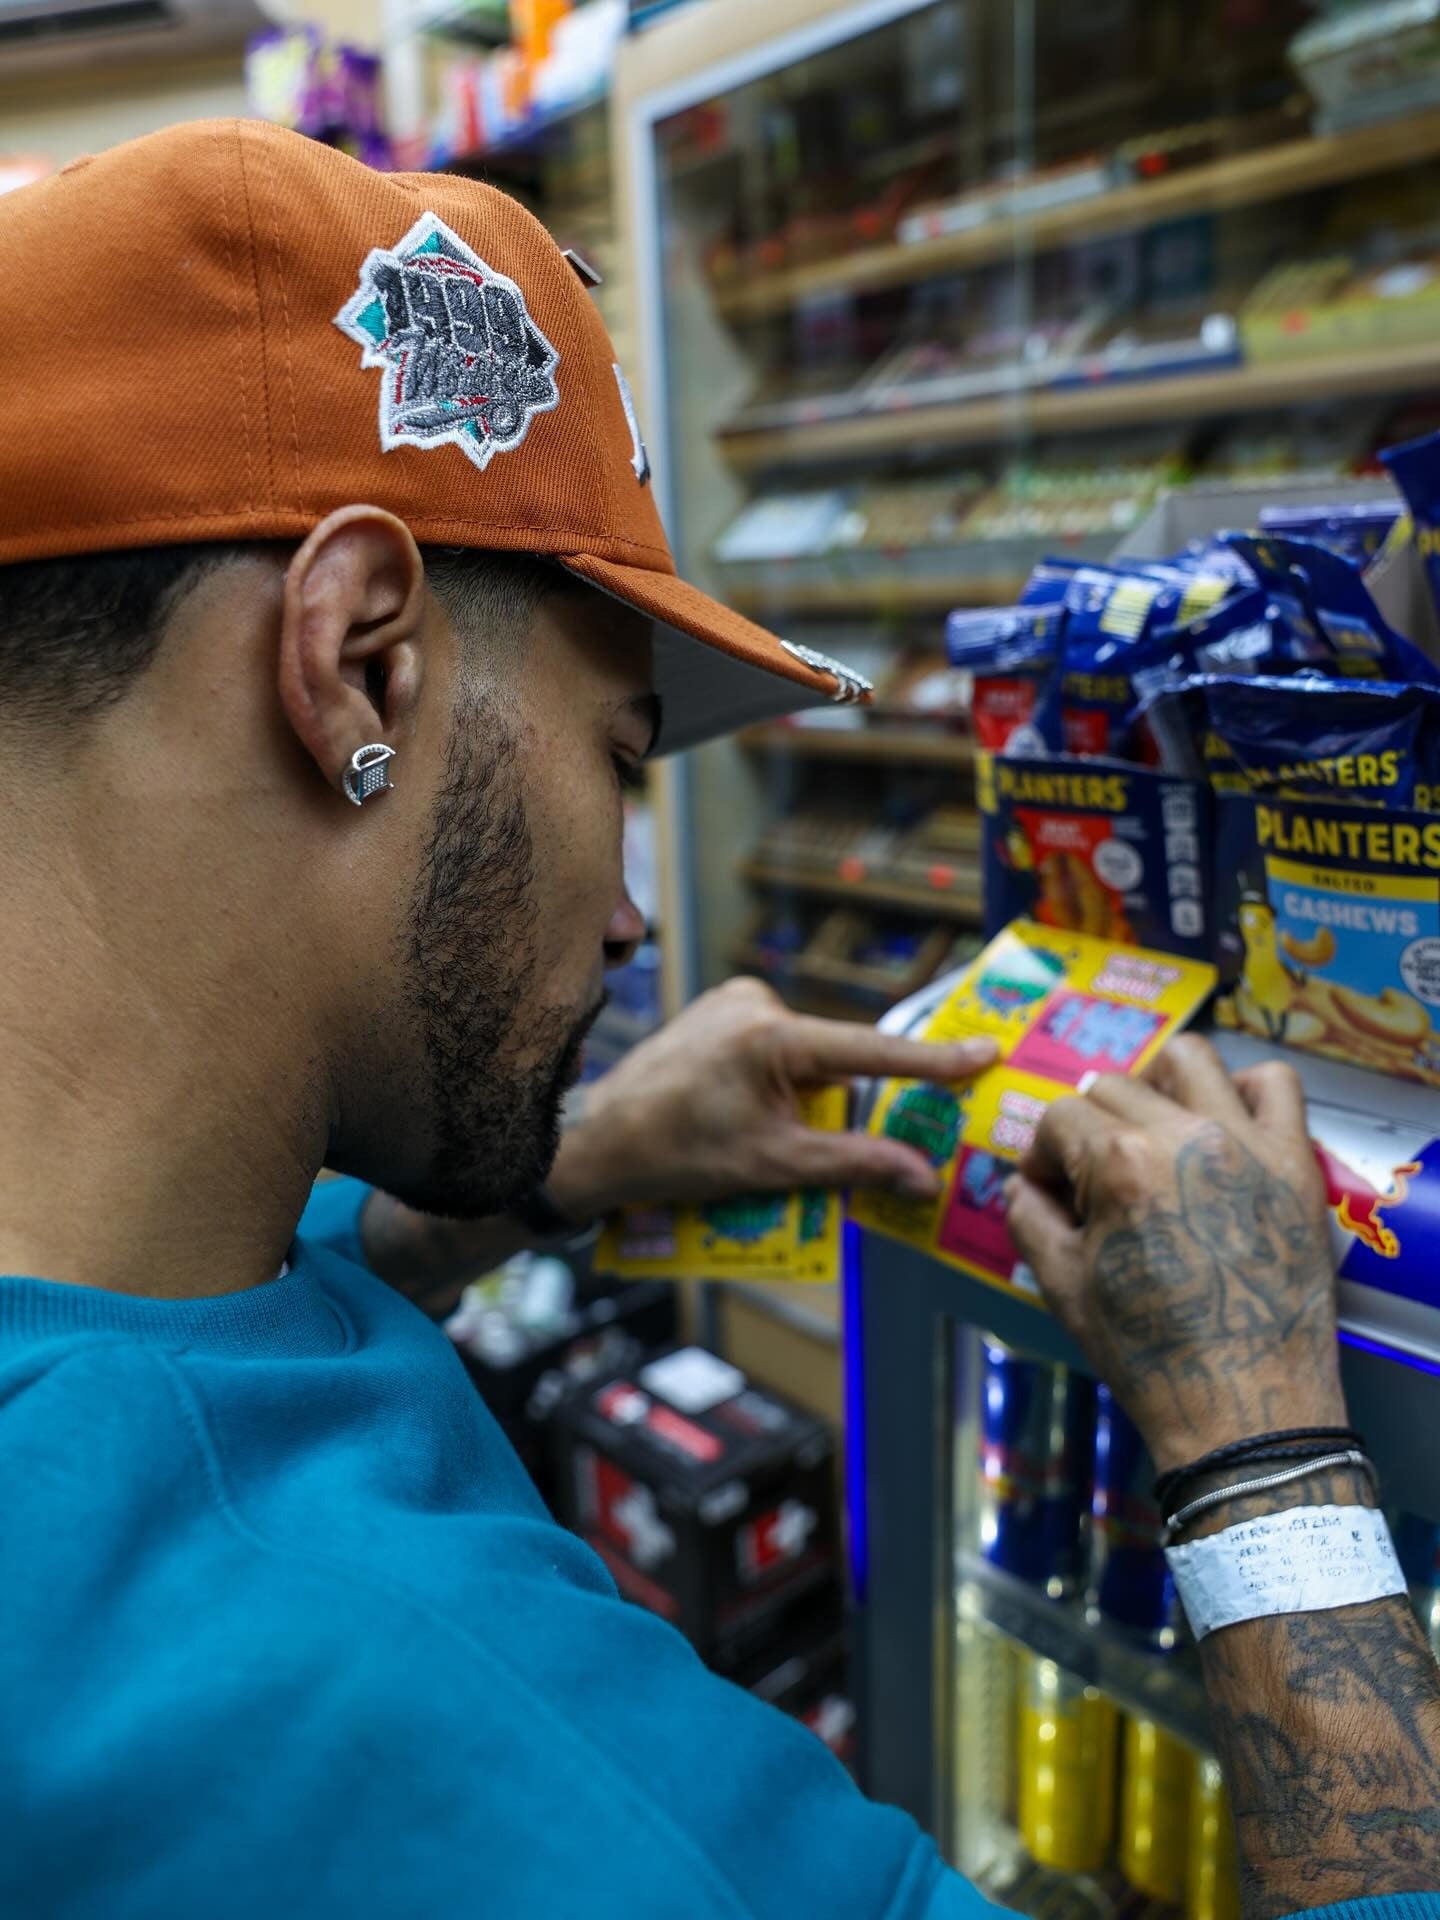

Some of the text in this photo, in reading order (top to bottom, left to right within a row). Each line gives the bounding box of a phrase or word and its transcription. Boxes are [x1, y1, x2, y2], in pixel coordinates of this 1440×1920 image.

[998, 766, 1127, 812] PLANTERS
[1255, 803, 1440, 870] PLANTERS
[1284, 892, 1418, 936] CASHEWS
